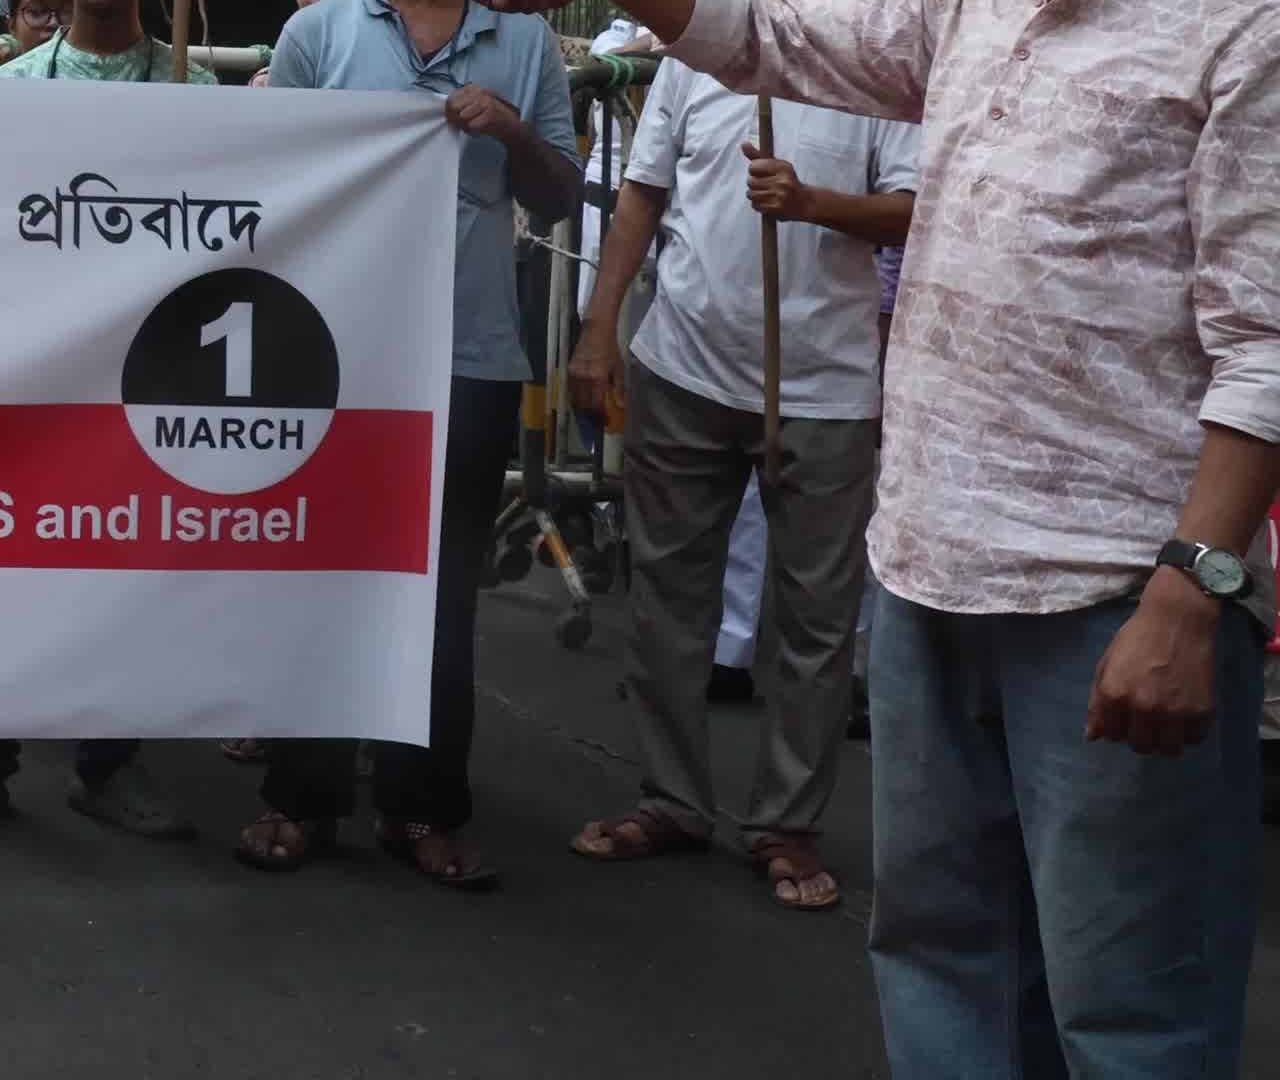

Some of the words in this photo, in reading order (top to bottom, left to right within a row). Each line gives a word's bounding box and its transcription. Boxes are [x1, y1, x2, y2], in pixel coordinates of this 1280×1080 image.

[17, 173, 262, 256] প্রতিবাদে
[200, 302, 257, 397] 1
[154, 416, 305, 453] MARCH
[34, 493, 139, 544] and
[160, 497, 307, 546] Israel
